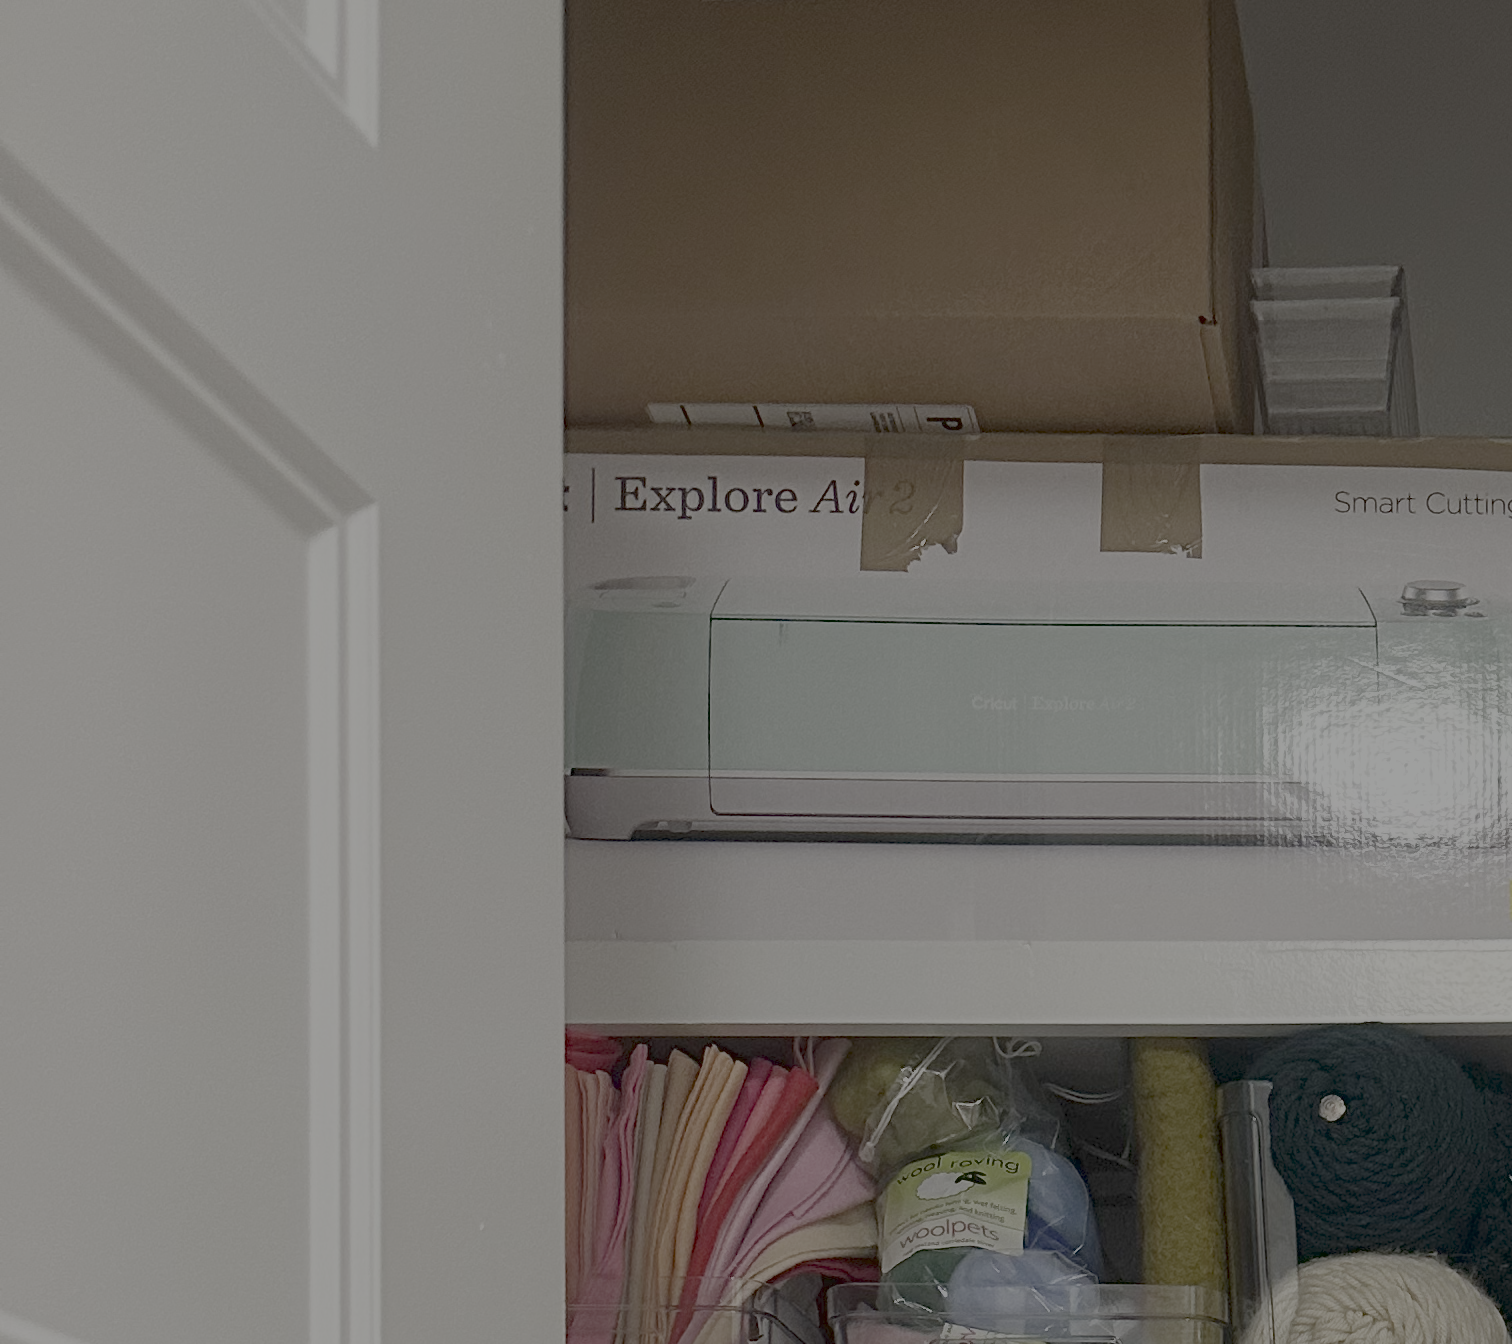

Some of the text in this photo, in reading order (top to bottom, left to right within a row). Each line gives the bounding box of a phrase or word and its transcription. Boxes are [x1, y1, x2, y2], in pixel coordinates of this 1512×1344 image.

[614, 476, 871, 521] Explore Air
[1333, 491, 1416, 516] Smart
[950, 1155, 1020, 1174] roving
[899, 1218, 1000, 1249] woolpets
